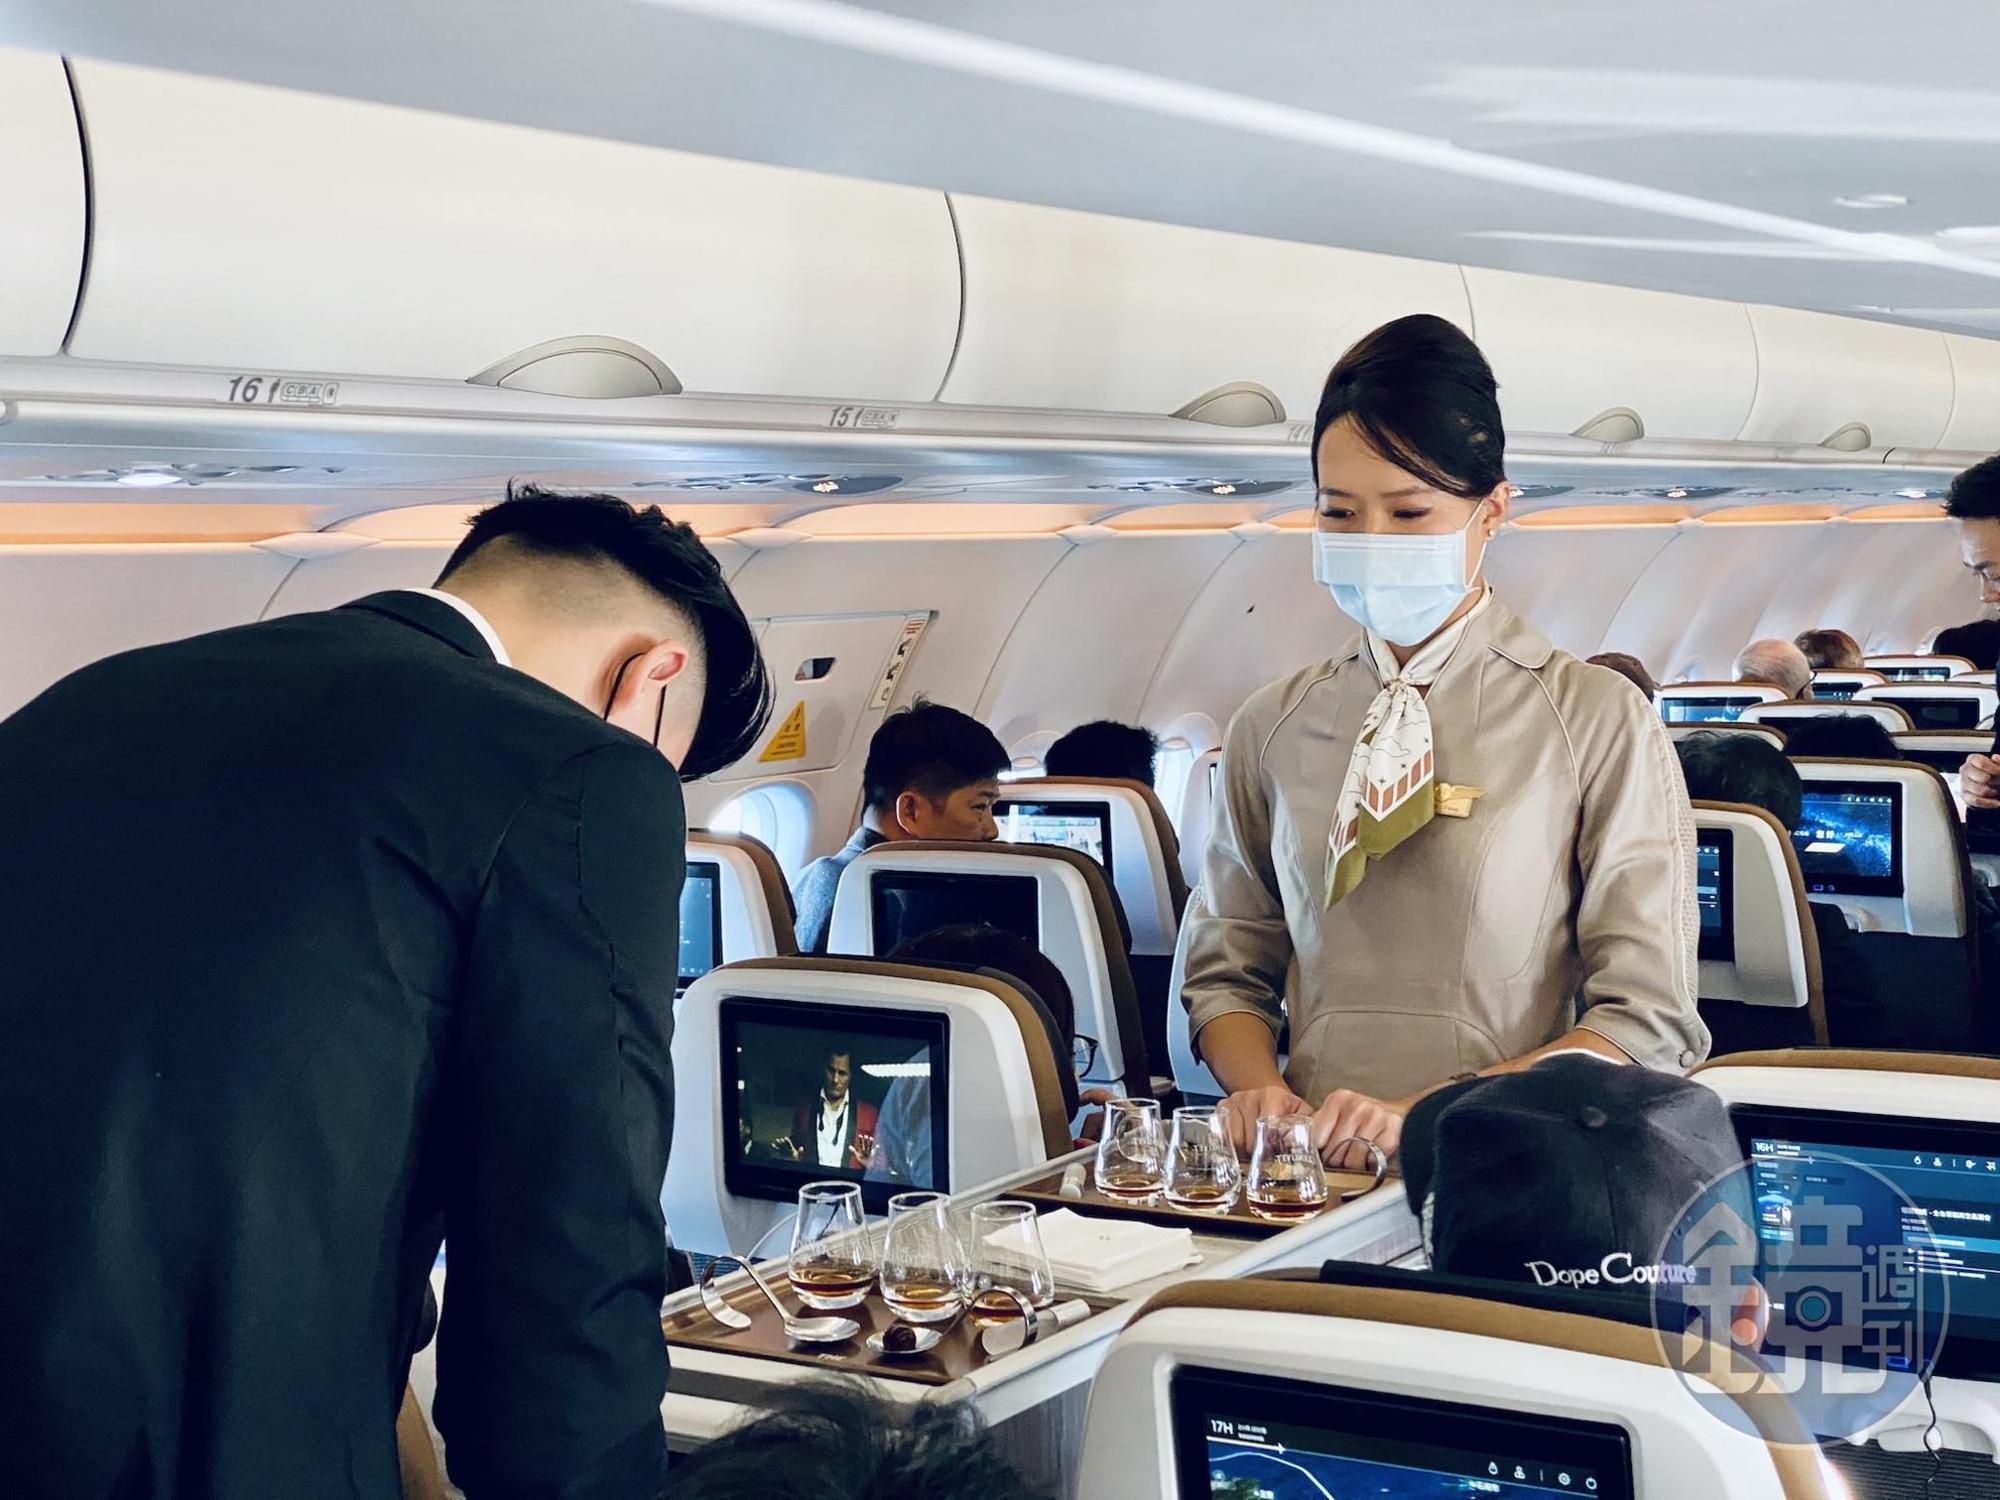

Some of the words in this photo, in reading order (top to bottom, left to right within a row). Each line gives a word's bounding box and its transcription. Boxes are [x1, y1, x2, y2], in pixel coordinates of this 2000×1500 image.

[229, 376, 263, 403] 16
[829, 406, 854, 427] 15
[1755, 1142, 1774, 1153] 16H
[1524, 1260, 1600, 1289] Dope
[1600, 1252, 1697, 1284] Couture
[1211, 1419, 1234, 1435] 17H
